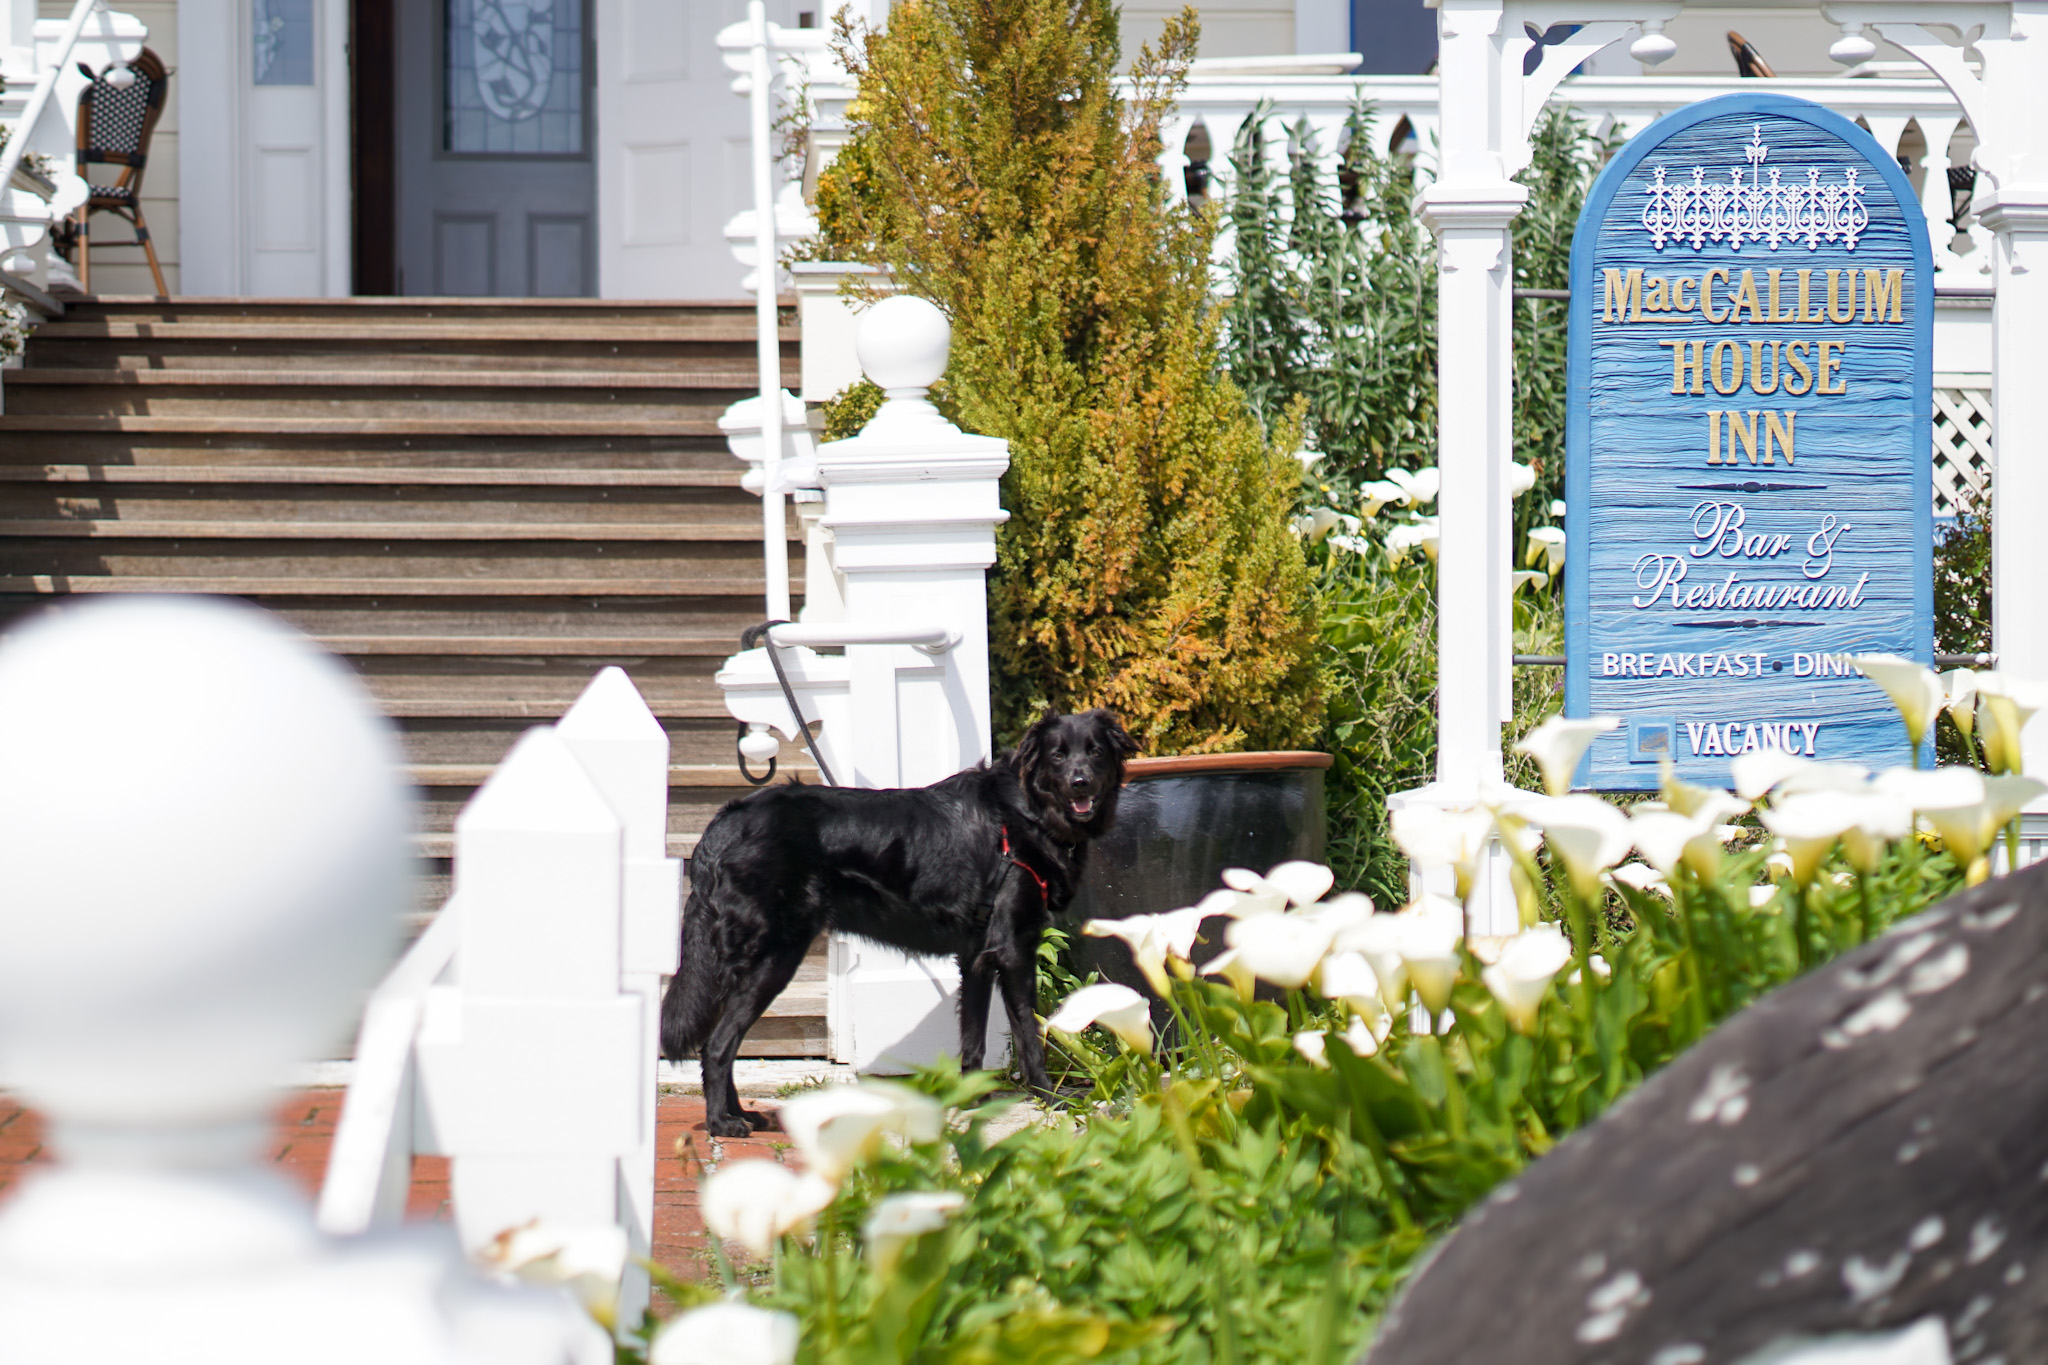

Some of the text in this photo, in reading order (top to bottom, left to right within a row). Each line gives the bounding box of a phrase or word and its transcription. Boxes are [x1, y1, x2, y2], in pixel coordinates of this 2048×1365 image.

[1602, 269, 1905, 323] MacCALLUM
[1659, 340, 1847, 395] HOUSE
[1707, 411, 1796, 465] INN
[1689, 501, 1851, 579] Bar &
[1632, 553, 1870, 610] Restaurant
[1602, 652, 1894, 677] BREAKFAST DINN
[1686, 722, 1820, 756] VACANCY
